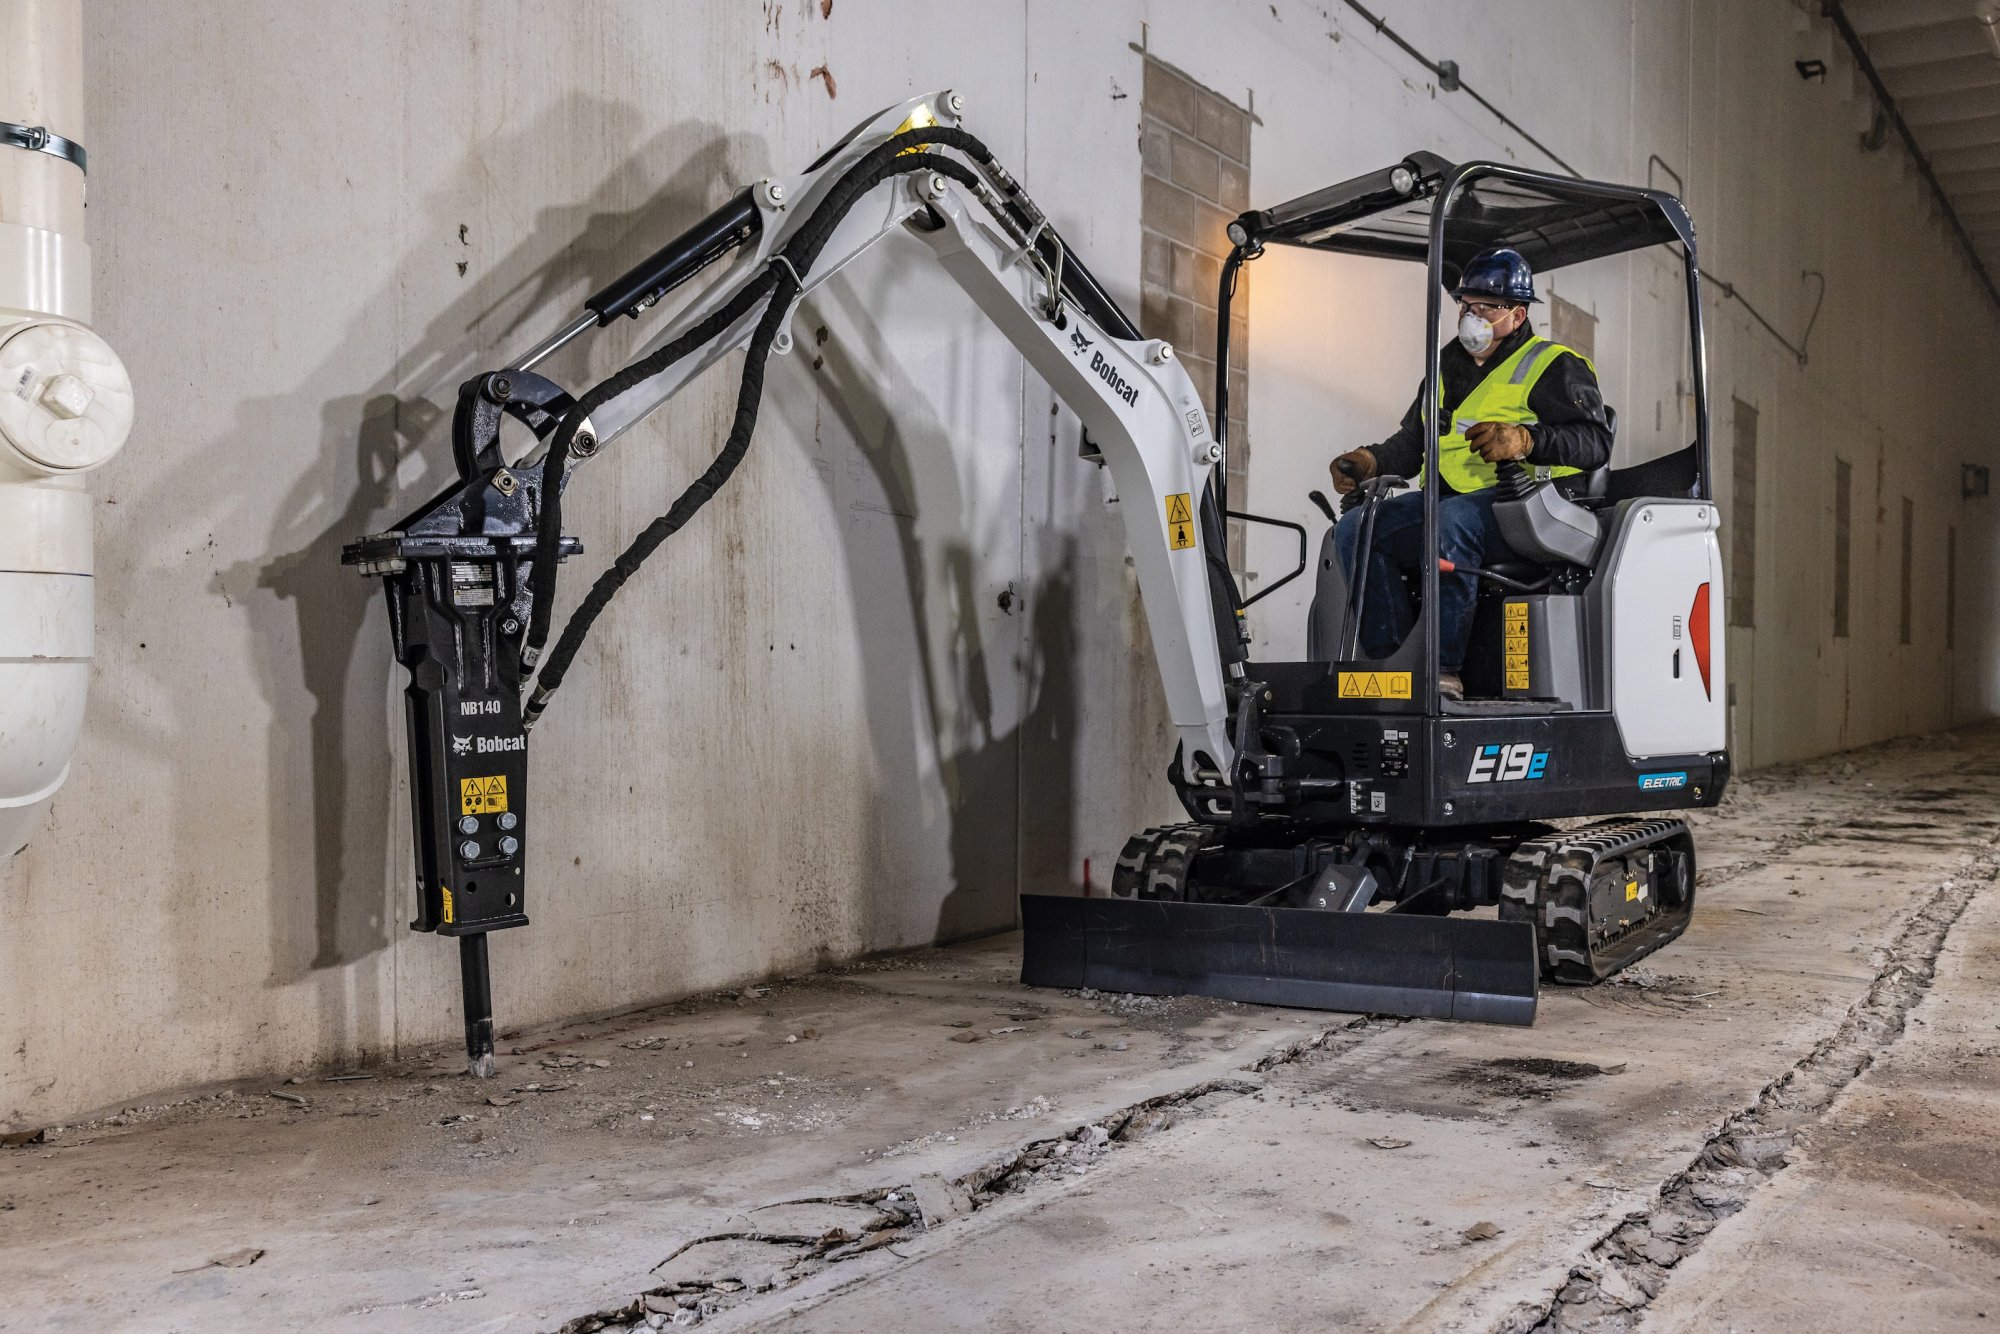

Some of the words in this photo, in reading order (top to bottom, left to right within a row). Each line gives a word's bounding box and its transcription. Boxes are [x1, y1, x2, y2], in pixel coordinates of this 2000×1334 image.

[1090, 350, 1139, 408] Bobcat
[460, 700, 501, 716] NB140
[476, 734, 526, 754] Bobcat
[1466, 743, 1549, 784] E19e
[1642, 776, 1684, 789] ELECTRIC
